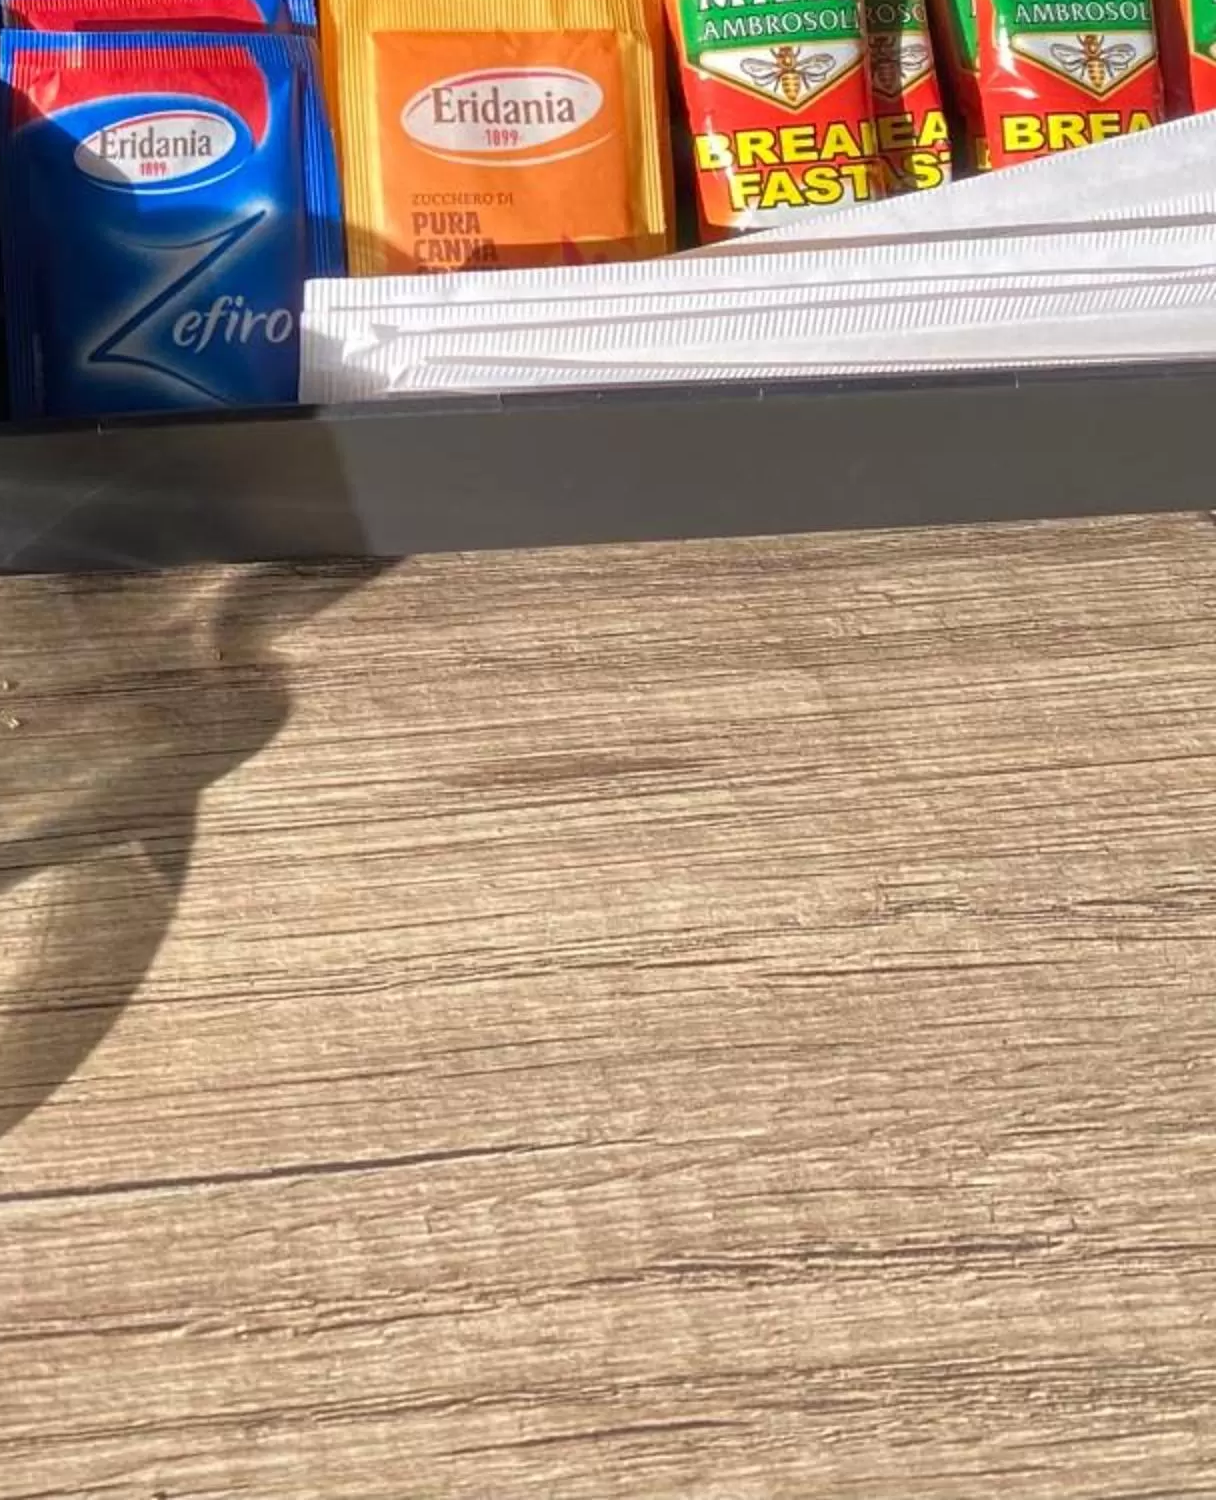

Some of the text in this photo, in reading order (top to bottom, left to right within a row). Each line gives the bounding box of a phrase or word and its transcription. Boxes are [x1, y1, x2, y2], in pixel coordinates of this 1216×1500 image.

[1015, 0, 1152, 24] AMBROSOL
[431, 85, 576, 124] Eridania
[99, 126, 214, 160] Eridania
[484, 129, 520, 147] 1899
[999, 111, 1154, 152] BREA
[411, 193, 514, 207] ZUCCHERO DI
[731, 161, 870, 212] FAST
[412, 211, 482, 235] PURA
[413, 238, 499, 263] CANNA
[87, 209, 294, 402] Zefiro
